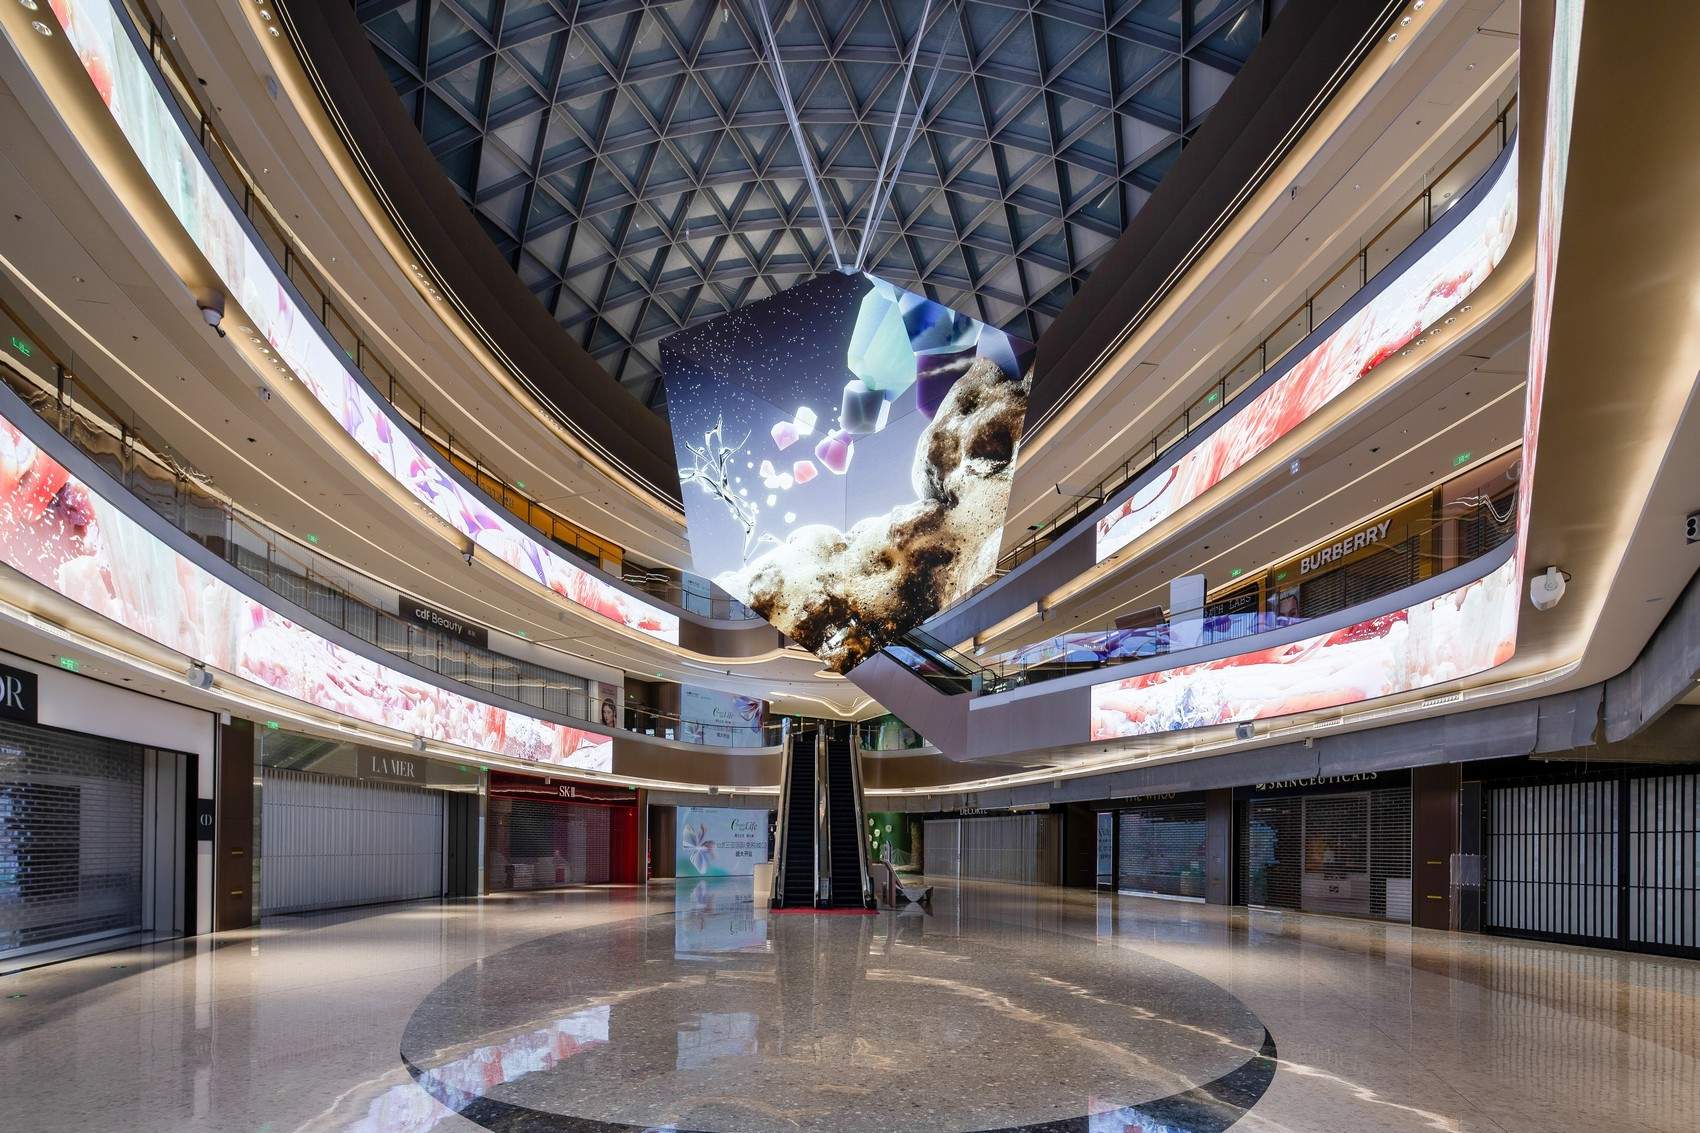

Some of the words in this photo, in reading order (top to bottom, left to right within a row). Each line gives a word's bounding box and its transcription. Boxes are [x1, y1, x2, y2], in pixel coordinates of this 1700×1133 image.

[1300, 519, 1392, 574] BURBERRY
[415, 608, 430, 621] cdf
[431, 612, 462, 635] Beauty
[0, 675, 25, 711] R
[372, 756, 389, 774] LA
[391, 760, 415, 778] MER
